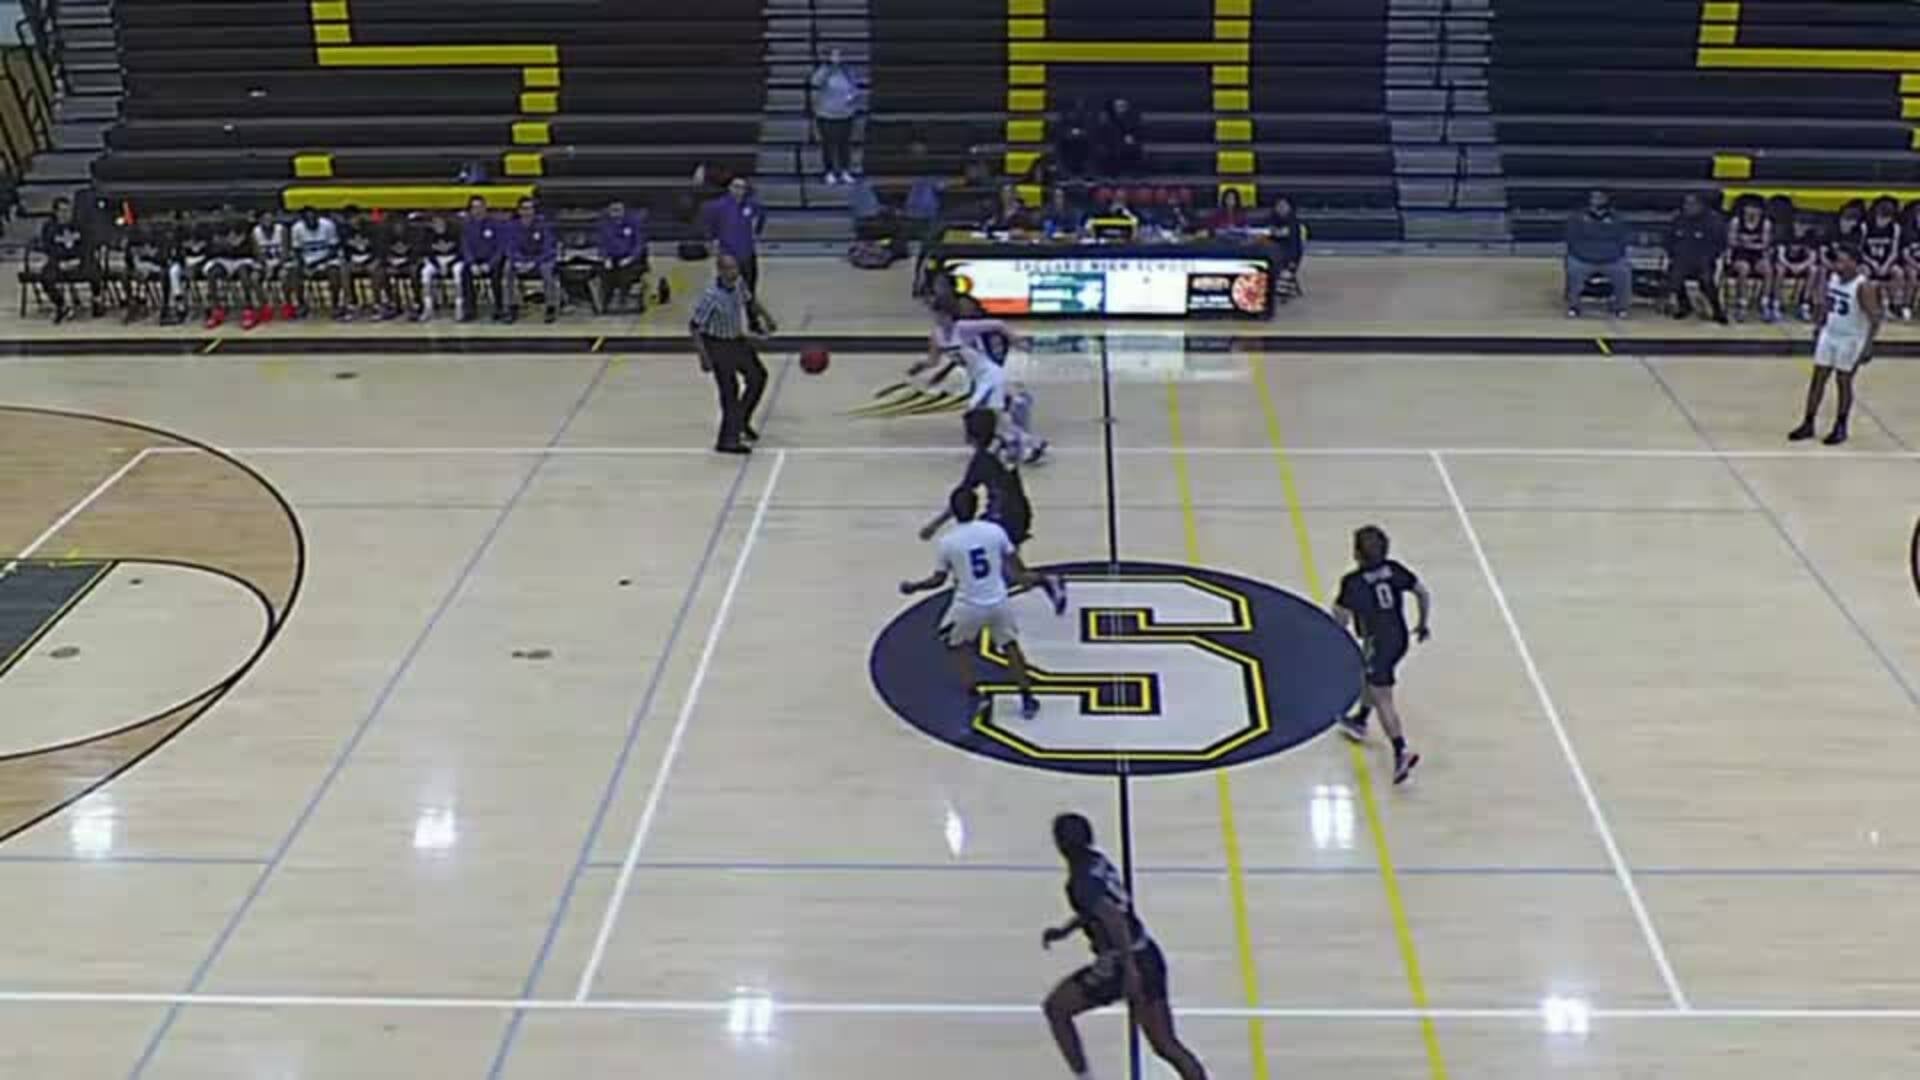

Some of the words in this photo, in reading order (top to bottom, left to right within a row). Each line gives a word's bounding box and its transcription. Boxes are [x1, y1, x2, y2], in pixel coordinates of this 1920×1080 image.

[970, 547, 990, 579] 5
[1375, 581, 1395, 609] 0
[971, 574, 1269, 761] S
